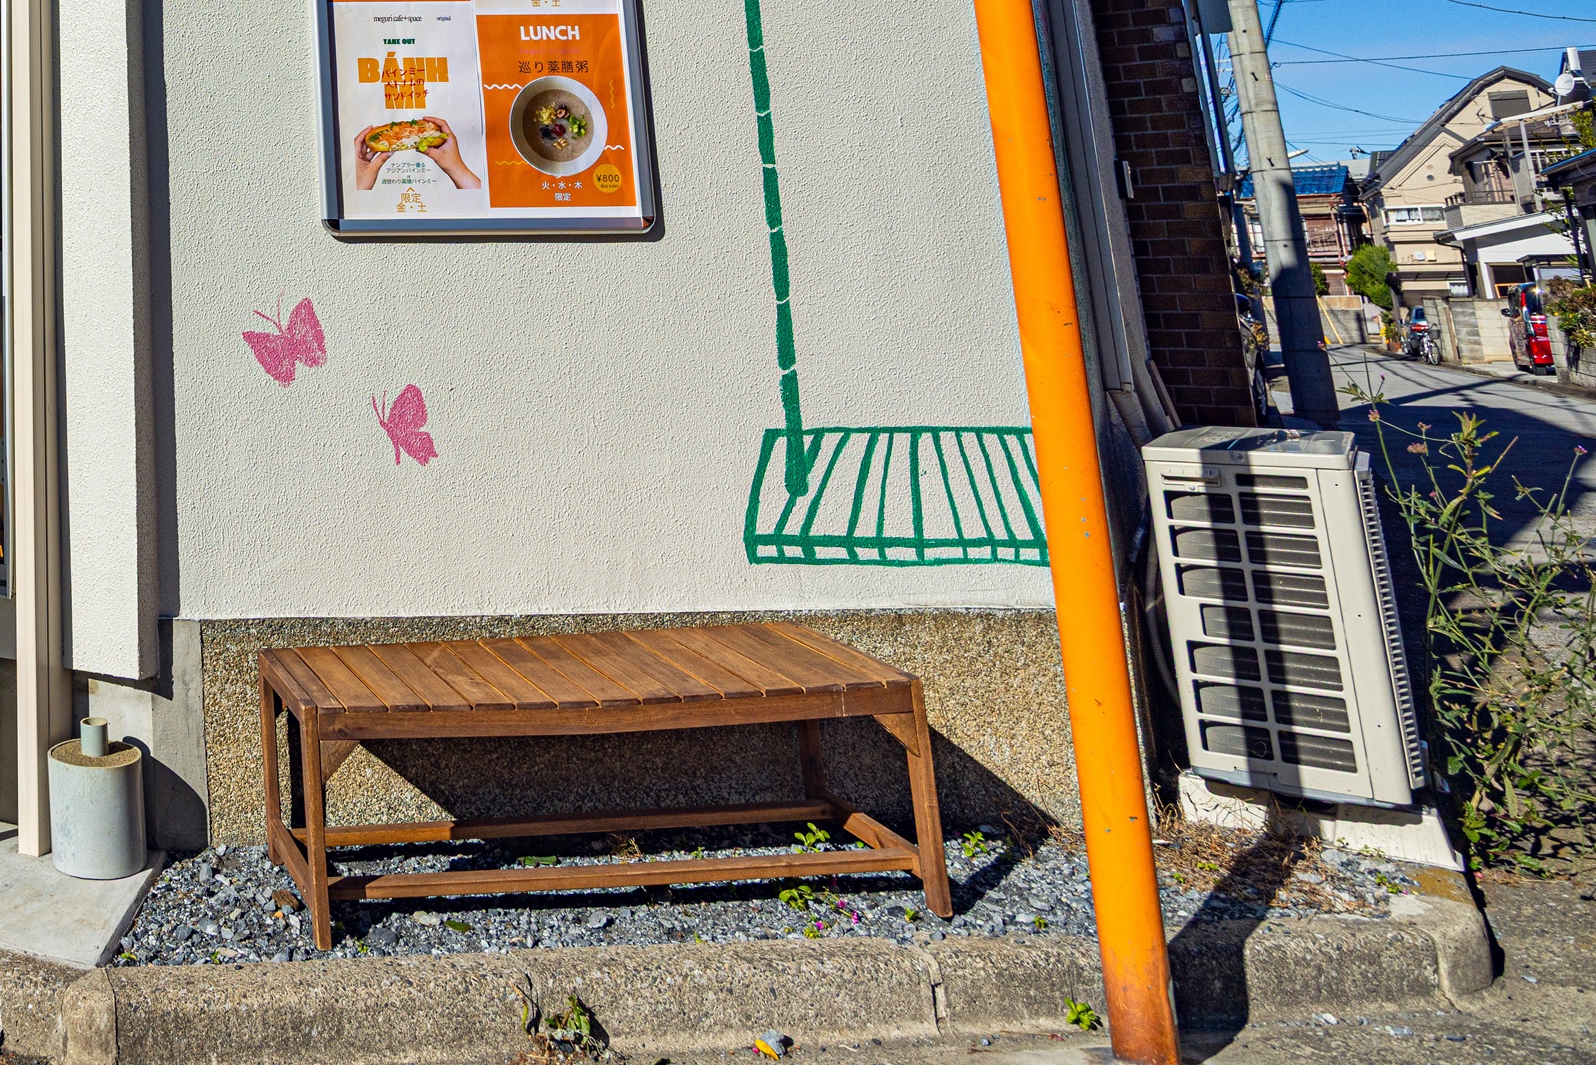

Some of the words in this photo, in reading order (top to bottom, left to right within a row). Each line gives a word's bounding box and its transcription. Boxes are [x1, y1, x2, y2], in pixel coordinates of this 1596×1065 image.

[520, 26, 580, 40] LUNCH
[357, 51, 449, 83] BÁNH
[518, 61, 588, 73] 巡り薬膳粥
[381, 67, 425, 78] バインミー
[384, 89, 429, 101] サンドイッチ
[596, 174, 620, 182] ¥800
[542, 181, 582, 189] 火・水・木
[401, 193, 421, 203] 限定
[555, 193, 571, 201] 限定
[396, 202, 427, 212] 金・土
